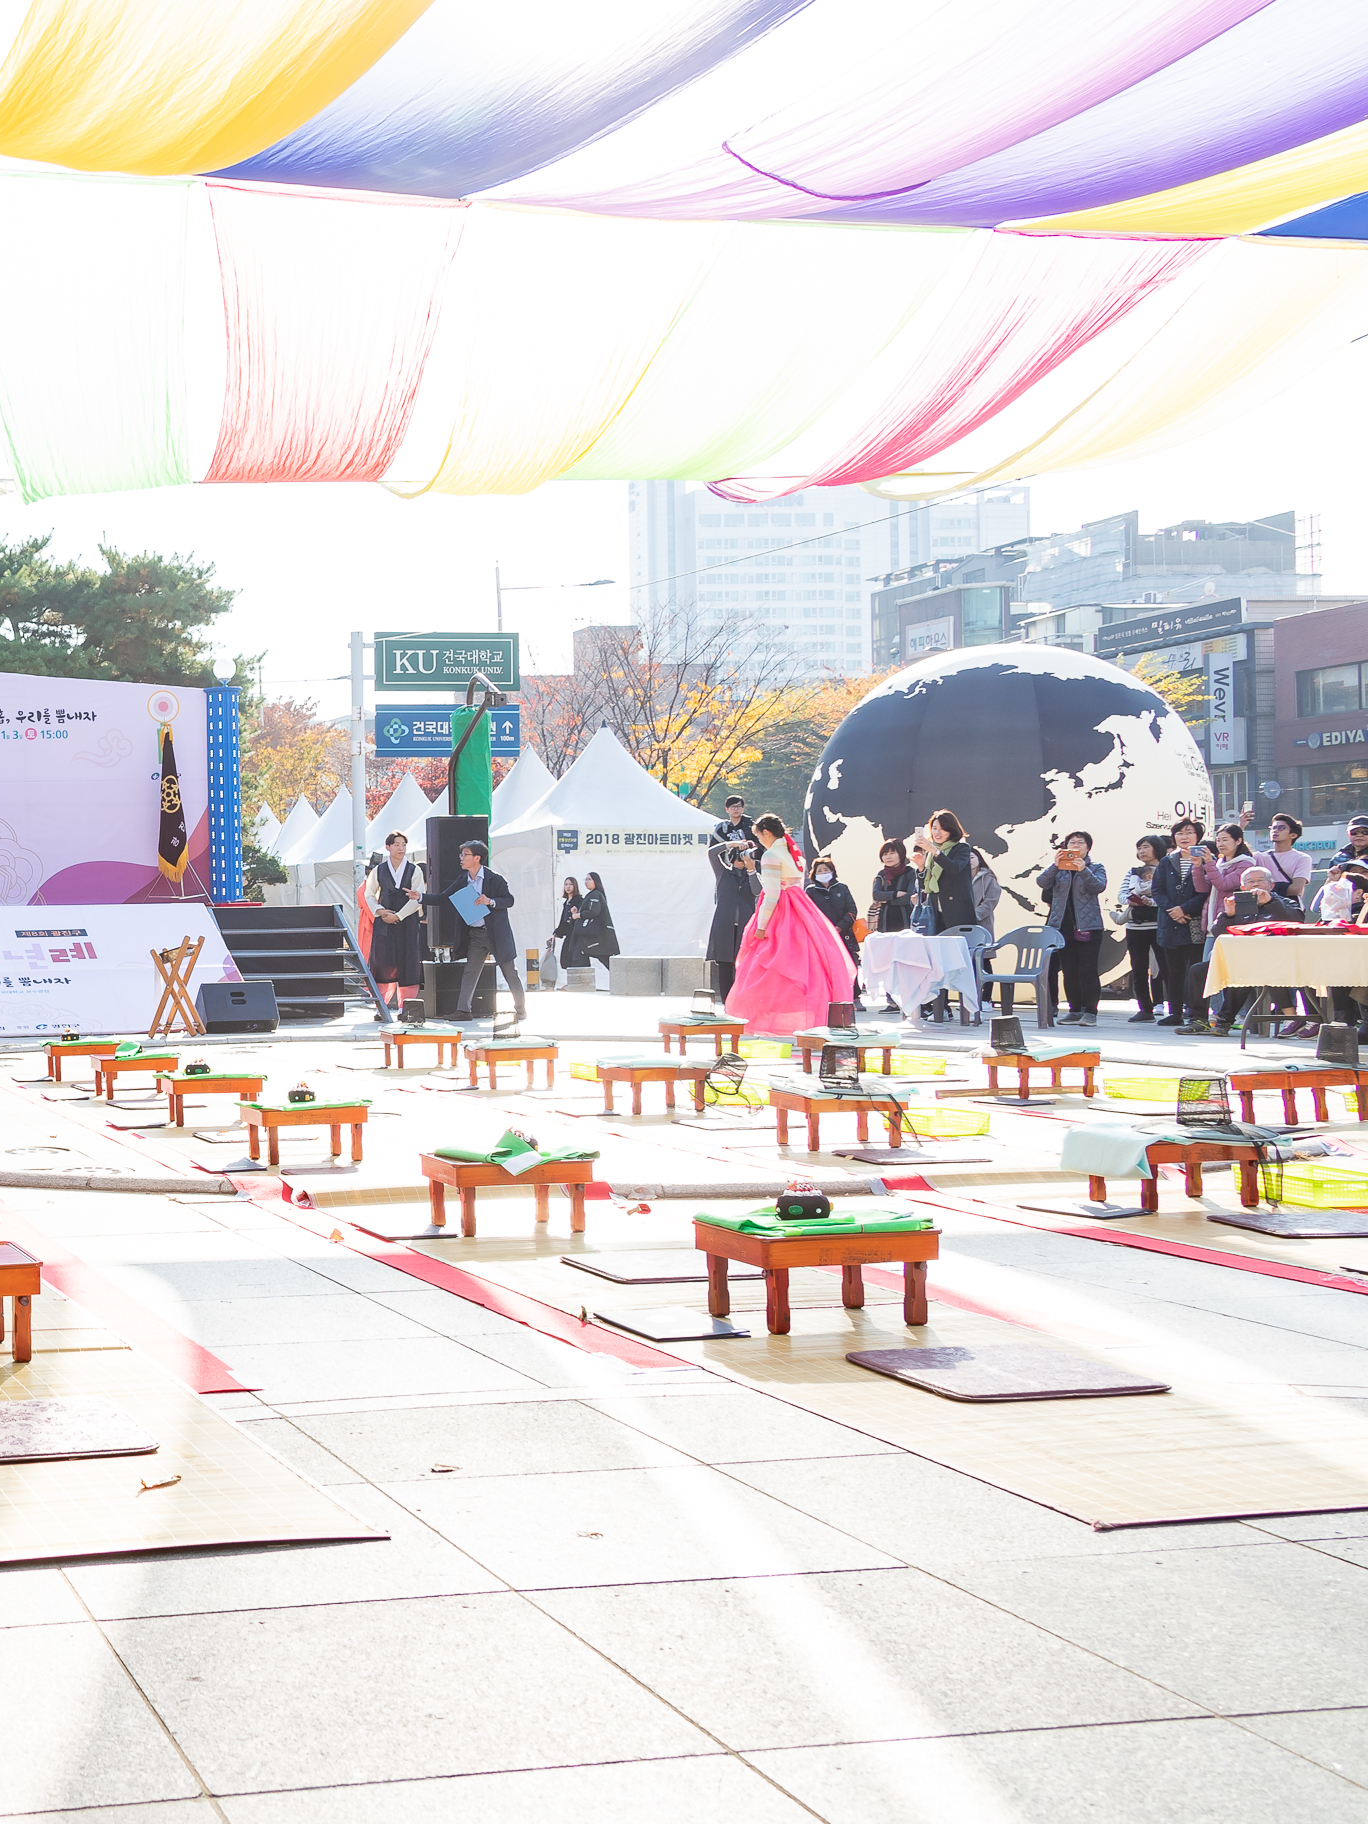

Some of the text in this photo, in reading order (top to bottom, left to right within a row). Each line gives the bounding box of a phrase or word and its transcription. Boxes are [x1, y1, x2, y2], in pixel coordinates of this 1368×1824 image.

[392, 649, 439, 674] KU
[442, 649, 504, 664] 건국대학교
[443, 666, 504, 674] KONKUK UNIV.
[1214, 667, 1230, 722] Wevr
[15, 708, 52, 725] 우리를
[55, 708, 97, 724] 뽐내자
[40, 729, 68, 740] 15:00
[1214, 732, 1229, 742] VR
[1322, 729, 1366, 746] EDIYA
[1157, 811, 1172, 821] Hei
[586, 834, 620, 845] 2018
[624, 833, 693, 846] 광진아트마켓
[51, 930, 82, 938] 광진구
[18, 976, 72, 987] 뽐내자
